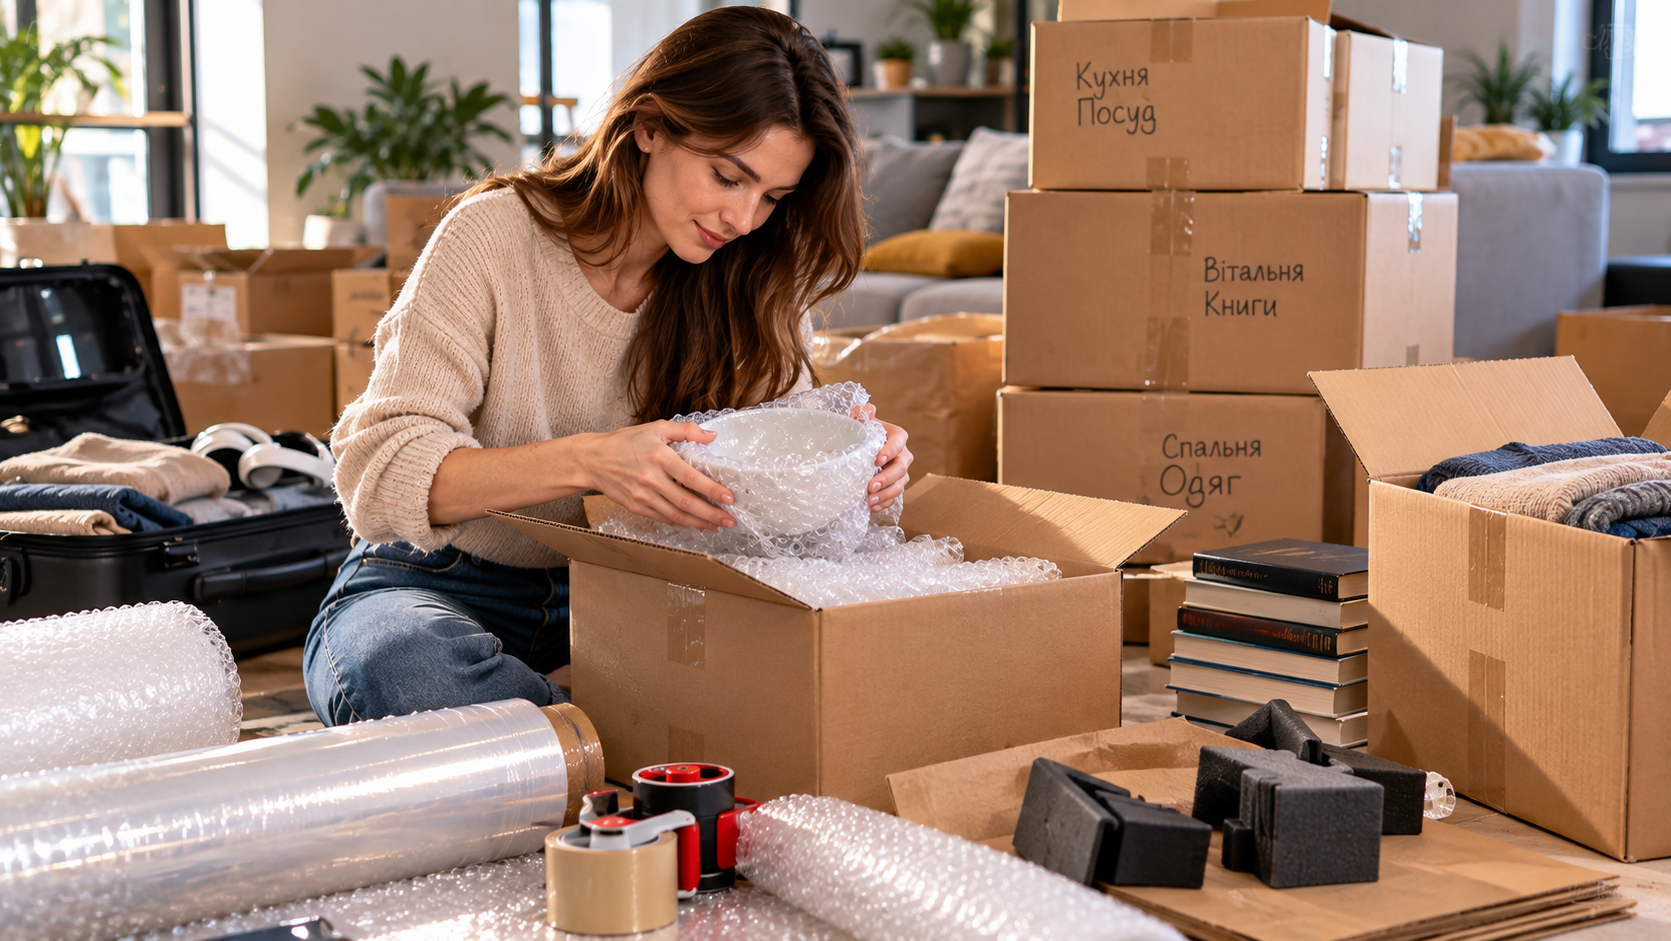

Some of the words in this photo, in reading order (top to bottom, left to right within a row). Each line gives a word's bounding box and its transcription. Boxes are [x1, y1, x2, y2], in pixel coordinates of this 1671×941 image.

[1077, 61, 1149, 100] Кухня
[1078, 97, 1156, 135] Посуд
[1204, 256, 1304, 283] Вітальня
[1205, 290, 1277, 317] Книги
[1162, 433, 1261, 459] Спальня
[1160, 465, 1242, 508] Одяг
